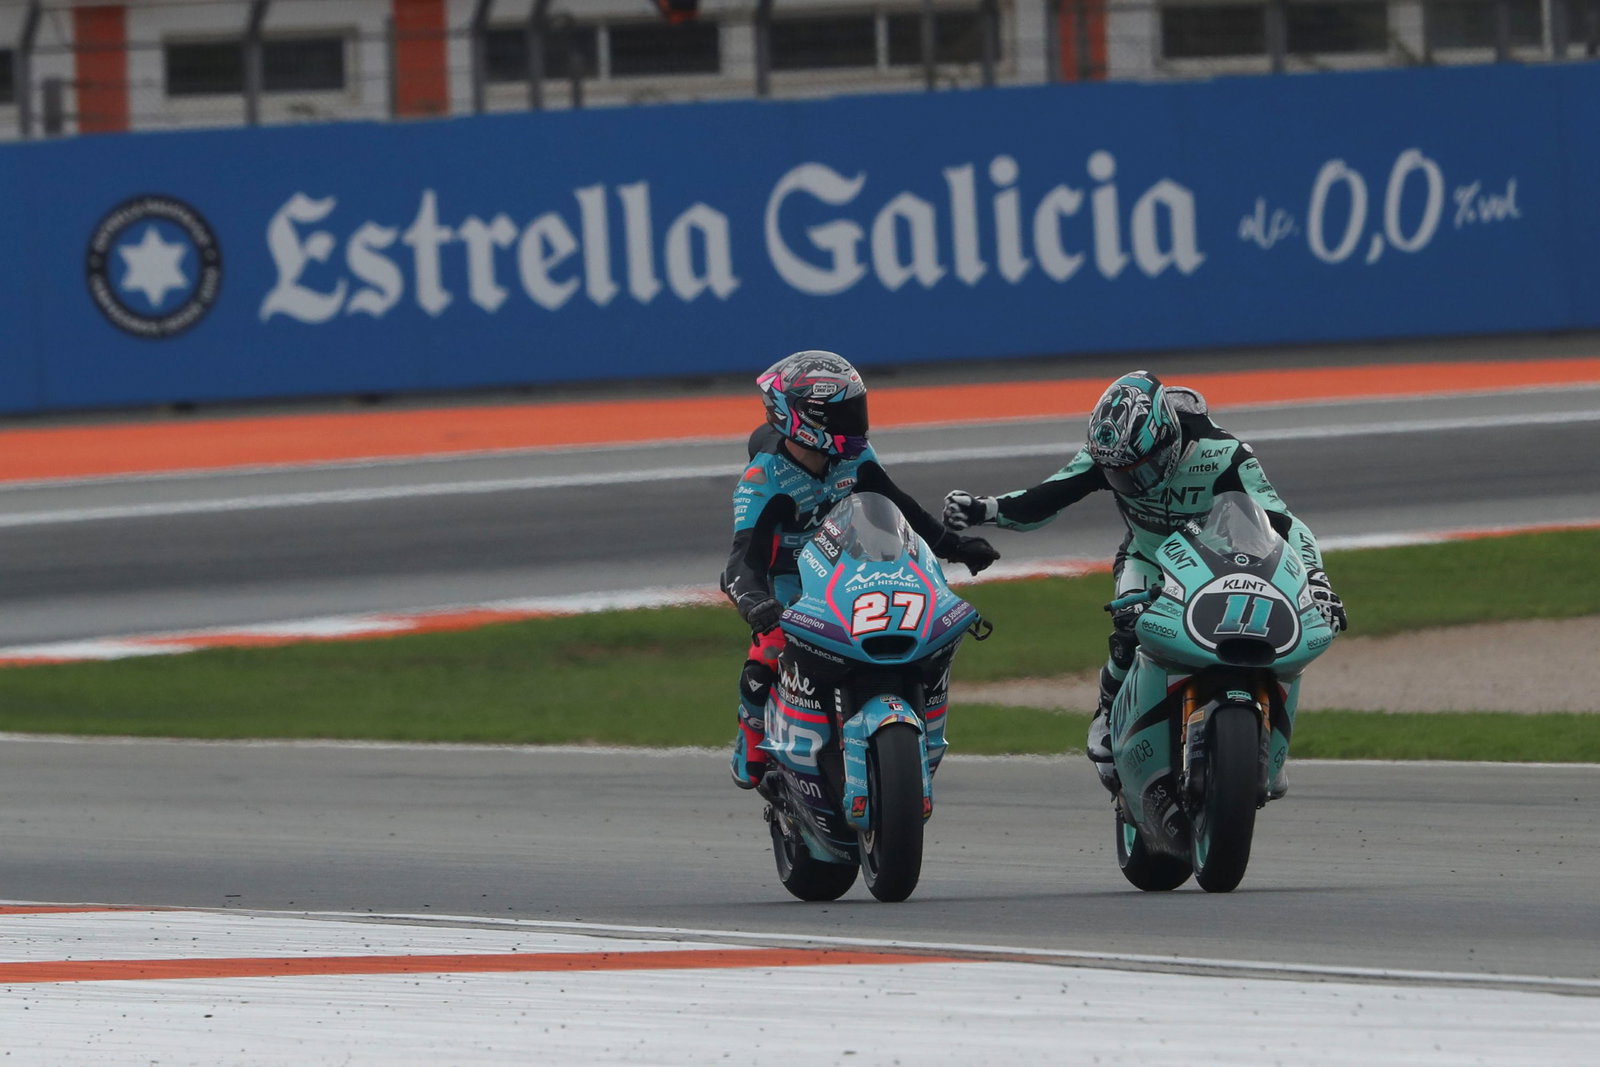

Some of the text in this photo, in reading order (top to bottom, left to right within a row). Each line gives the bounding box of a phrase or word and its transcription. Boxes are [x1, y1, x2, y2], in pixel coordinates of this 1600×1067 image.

[259, 181, 739, 325] Estrella
[765, 150, 1206, 297] Galicia
[1201, 446, 1232, 459] KLINT
[802, 549, 828, 578] CFMOTO
[1163, 539, 1198, 570] KLINT
[846, 579, 920, 593] SOLER HISPANIA
[1222, 579, 1267, 592] KLINT
[792, 612, 825, 630] solunion
[851, 590, 926, 637] 27
[1213, 594, 1274, 637] 11
